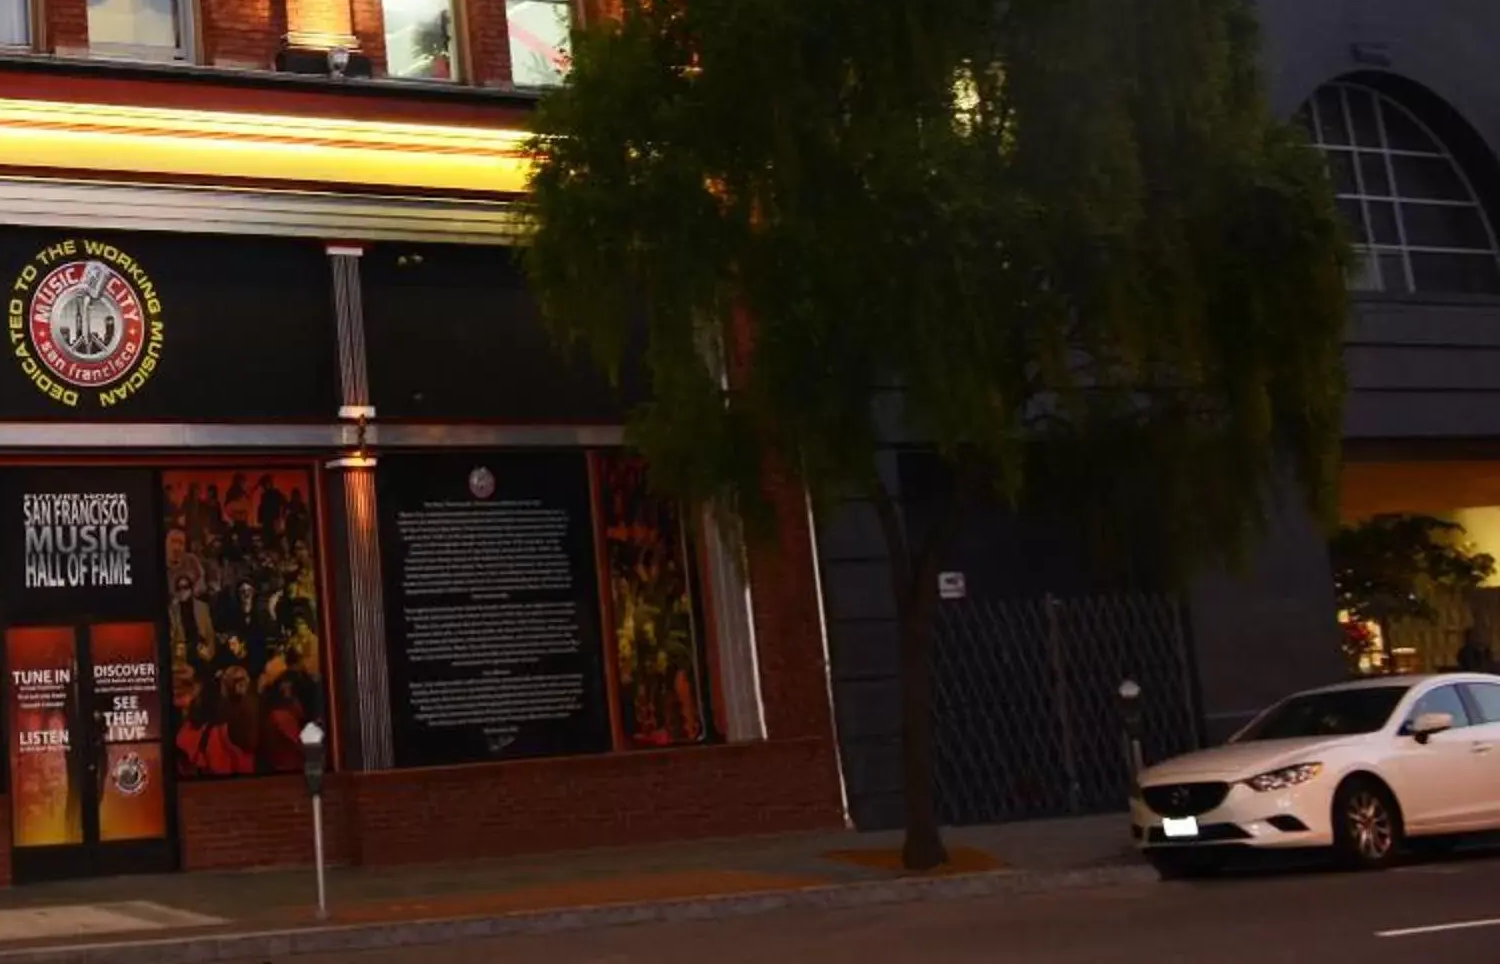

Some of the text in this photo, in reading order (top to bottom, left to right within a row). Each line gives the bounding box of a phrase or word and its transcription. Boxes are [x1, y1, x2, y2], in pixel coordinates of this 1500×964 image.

[33, 267, 142, 324] MUSIC CITY
[8, 239, 164, 407] DEDICATED TO THE WORKING MUSICIAN
[23, 499, 129, 525] SAN FRANCISCO
[25, 525, 130, 553] MUSIC
[25, 552, 133, 588] HALL OF FAME
[11, 669, 71, 685] TUNE IN
[93, 663, 155, 678] DISCOVER
[113, 696, 139, 710] SEE
[103, 710, 149, 726] THEM
[19, 729, 69, 745] LISTEN
